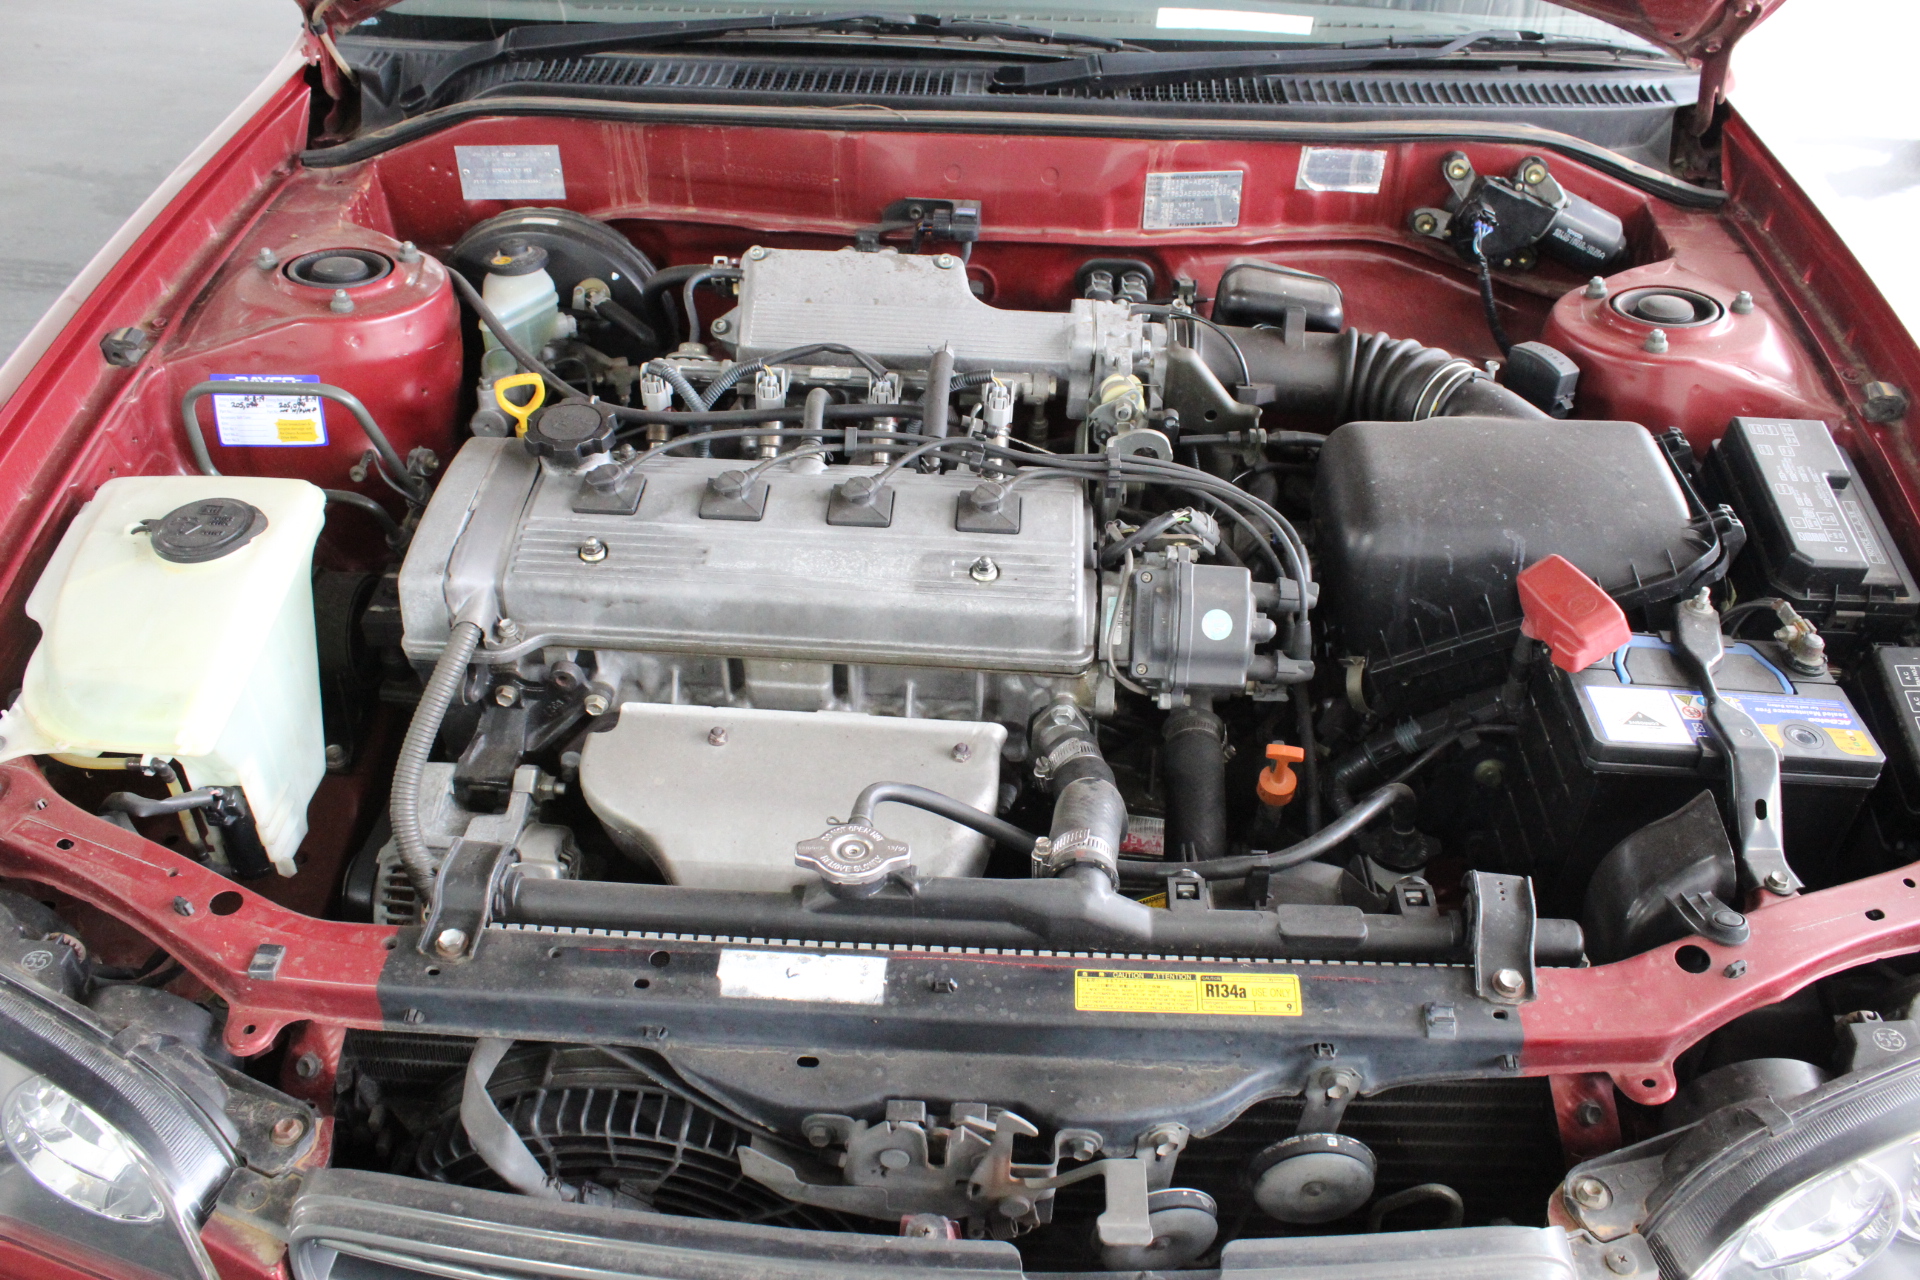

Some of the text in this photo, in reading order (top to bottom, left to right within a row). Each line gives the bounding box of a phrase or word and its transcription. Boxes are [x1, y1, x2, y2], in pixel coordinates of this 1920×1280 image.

[1773, 708, 1821, 716] Maintenance
[25, 954, 48, 969] 55
[1205, 984, 1290, 998] R134a USE ONLY
[1877, 1033, 1903, 1047] 55
